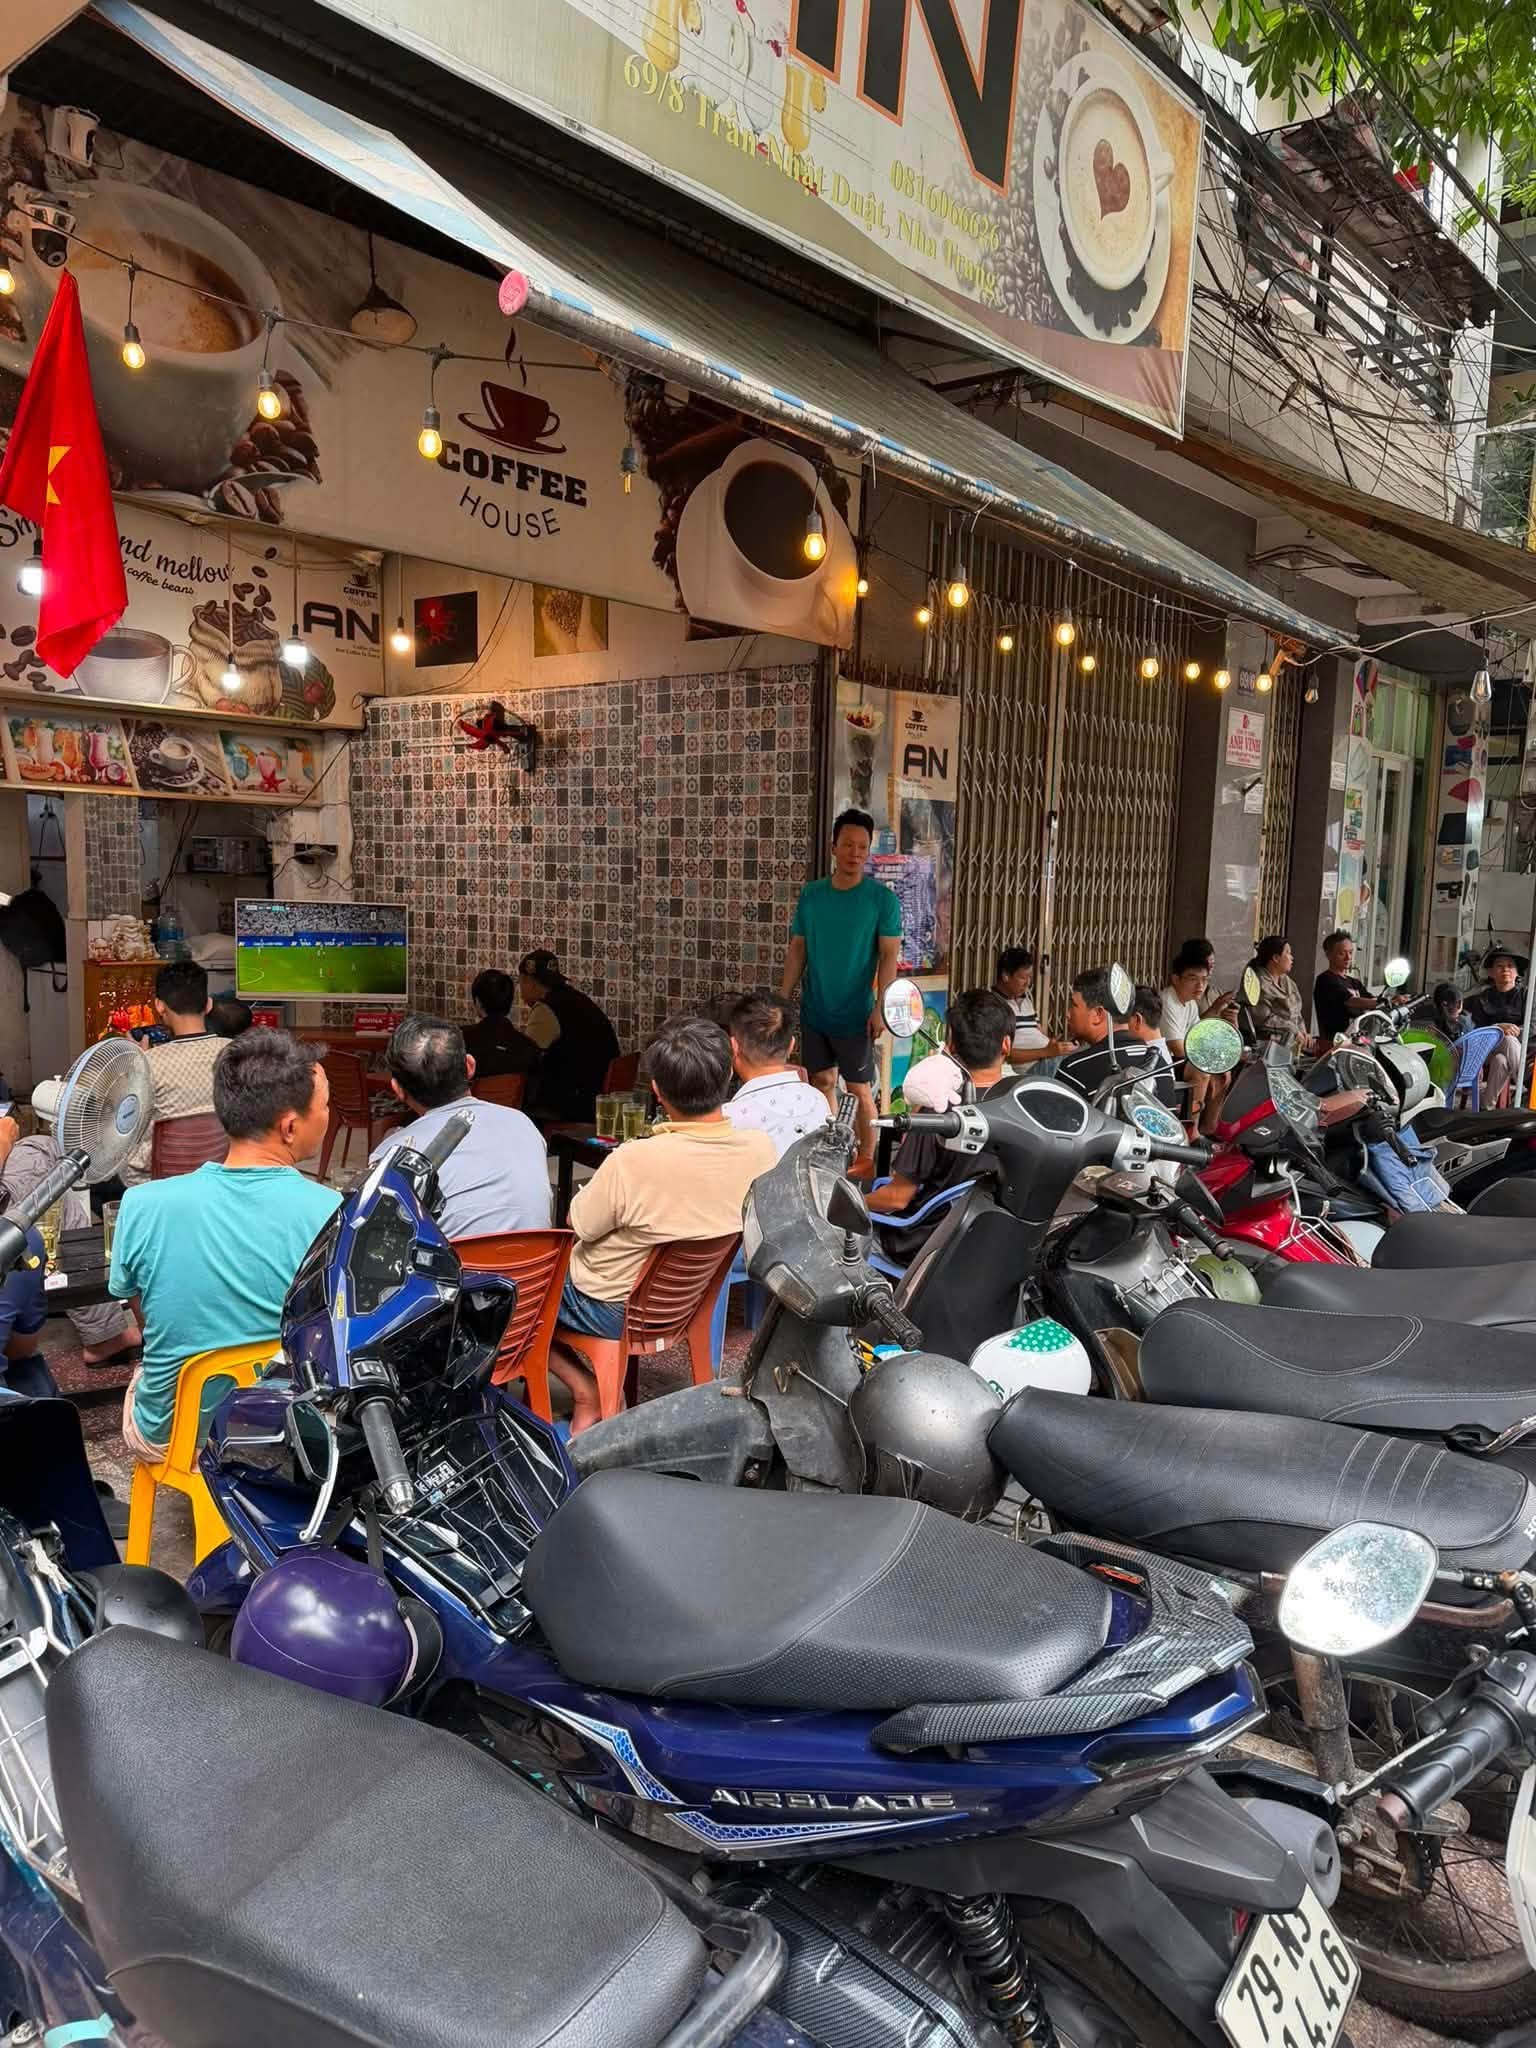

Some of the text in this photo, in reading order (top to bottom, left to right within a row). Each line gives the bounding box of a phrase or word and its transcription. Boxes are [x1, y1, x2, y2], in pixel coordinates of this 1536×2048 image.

[623, 54, 685, 114] 69/8
[898, 208, 938, 260] Nha
[943, 237, 997, 302] Trang
[437, 440, 588, 508] COFFEE
[459, 485, 561, 539] HOUSE
[119, 535, 152, 563] nd
[127, 567, 194, 595] coffee beans
[303, 601, 380, 645] AN
[903, 743, 949, 780] AN
[711, 1788, 956, 1812] AIRBLADE
